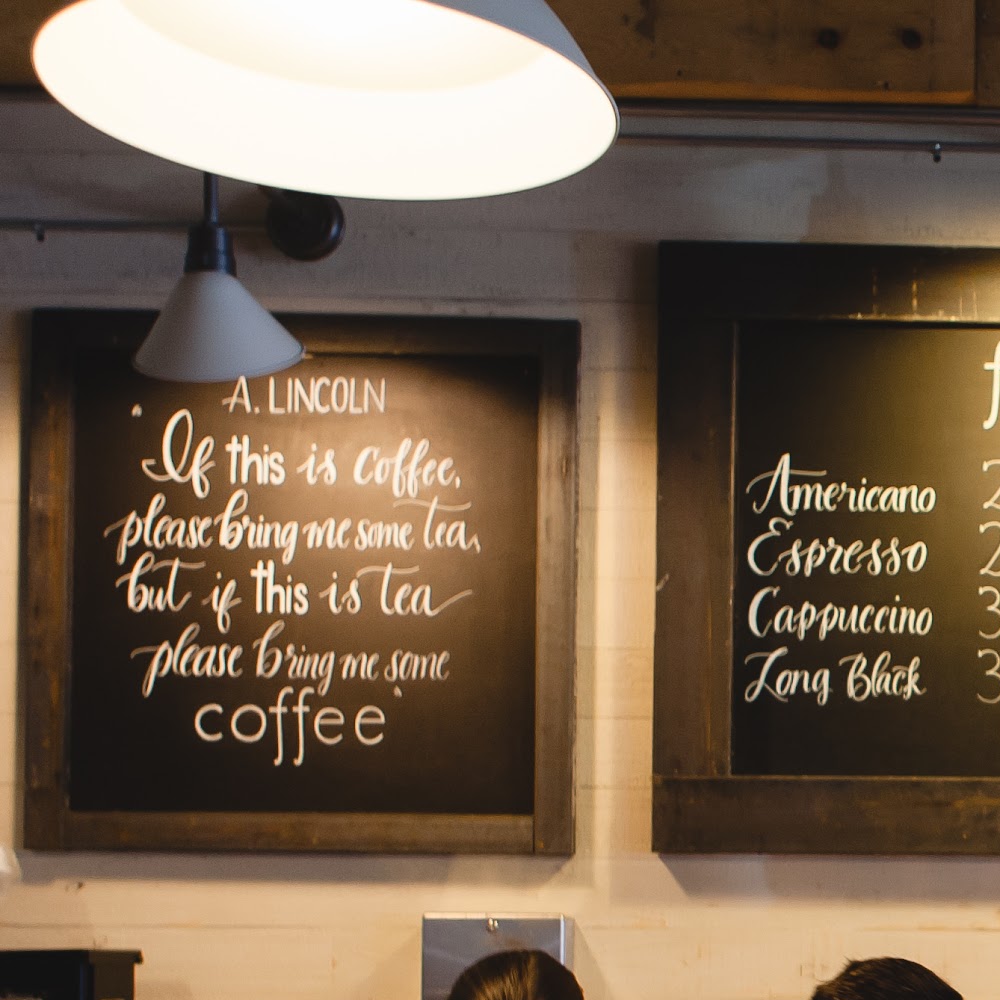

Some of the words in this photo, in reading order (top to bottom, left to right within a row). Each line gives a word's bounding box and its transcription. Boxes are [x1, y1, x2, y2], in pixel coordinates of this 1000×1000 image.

[221, 375, 260, 414] A.
[269, 376, 385, 414] LINCOLN
[225, 434, 286, 485] this
[296, 442, 337, 485] is
[745, 452, 937, 516] Americano
[104, 493, 213, 565] please
[214, 489, 298, 565] bring
[302, 516, 350, 550] me
[354, 518, 415, 550] some
[746, 516, 928, 578] Espresso
[115, 552, 206, 613] but
[203, 572, 241, 634] if
[250, 560, 309, 616] this
[320, 573, 361, 617] is
[357, 562, 473, 618] tea
[747, 585, 934, 641] Cappuccino
[130, 622, 243, 698] please
[253, 620, 336, 695] bring
[341, 648, 380, 681] me
[383, 648, 451, 682] some
[744, 645, 833, 706] Long
[838, 650, 927, 702] Black
